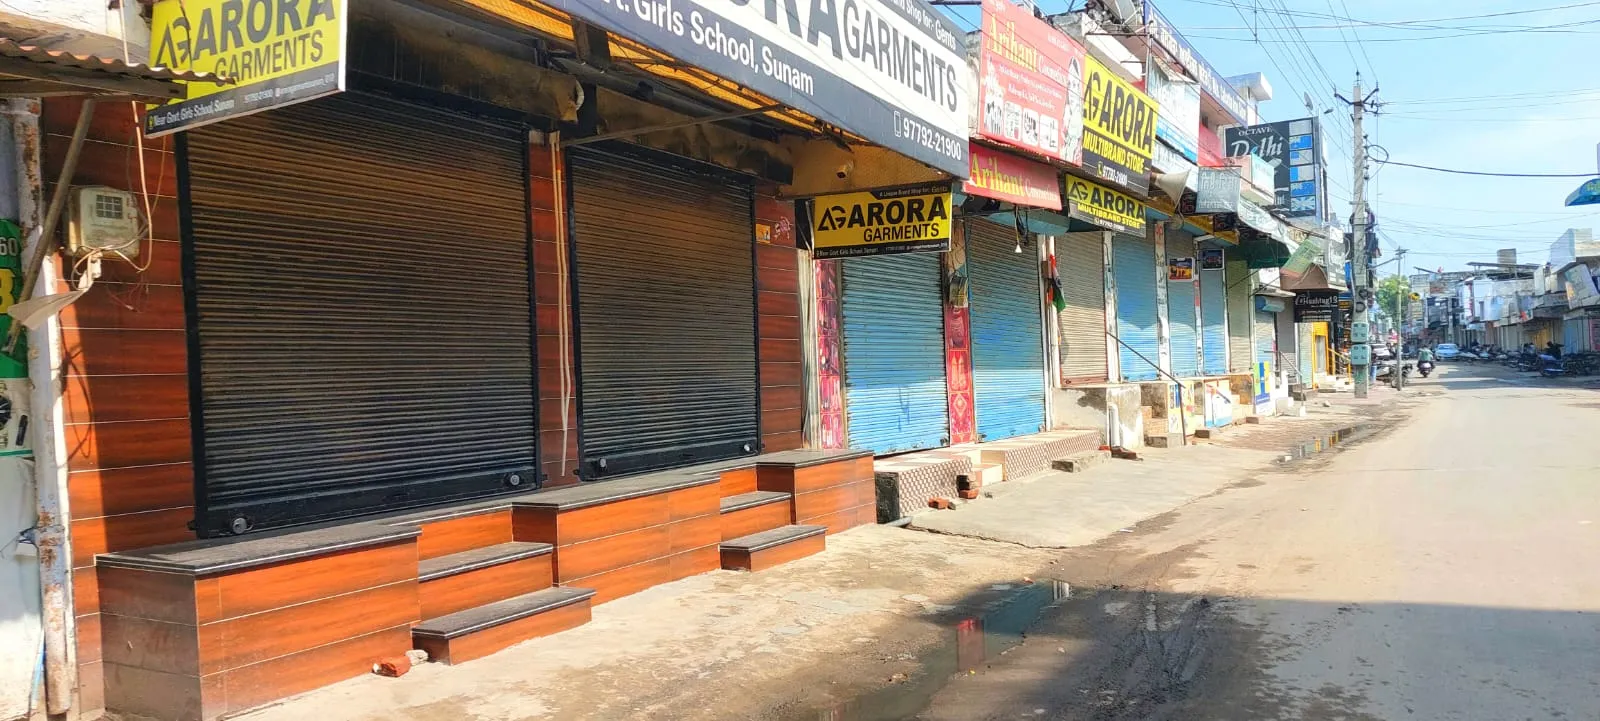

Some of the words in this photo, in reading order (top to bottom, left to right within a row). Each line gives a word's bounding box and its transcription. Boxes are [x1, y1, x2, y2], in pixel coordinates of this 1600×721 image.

[634, 0, 684, 36] Girls
[690, 11, 759, 73] School,
[762, 46, 814, 96] Sunam
[843, 0, 957, 112] GARMENTS
[935, 19, 957, 50] Gents
[986, 13, 1038, 73] Arihant
[215, 30, 324, 83] GARMENTS
[153, 114, 167, 126] Near
[181, 107, 194, 120] Girls
[214, 99, 235, 113] Sunam
[1098, 79, 1154, 154] ARORA
[903, 118, 962, 161] 97792-21900
[1083, 130, 1126, 166] MULTIBRAND
[1126, 150, 1145, 174] STORE
[971, 152, 1026, 197] Arihant
[847, 196, 947, 228] ARORA
[1077, 202, 1122, 224] MULTIBRAND
[1122, 217, 1141, 229] STORE
[1090, 187, 1145, 219] ARORA
[863, 223, 939, 242] GARMENTS
